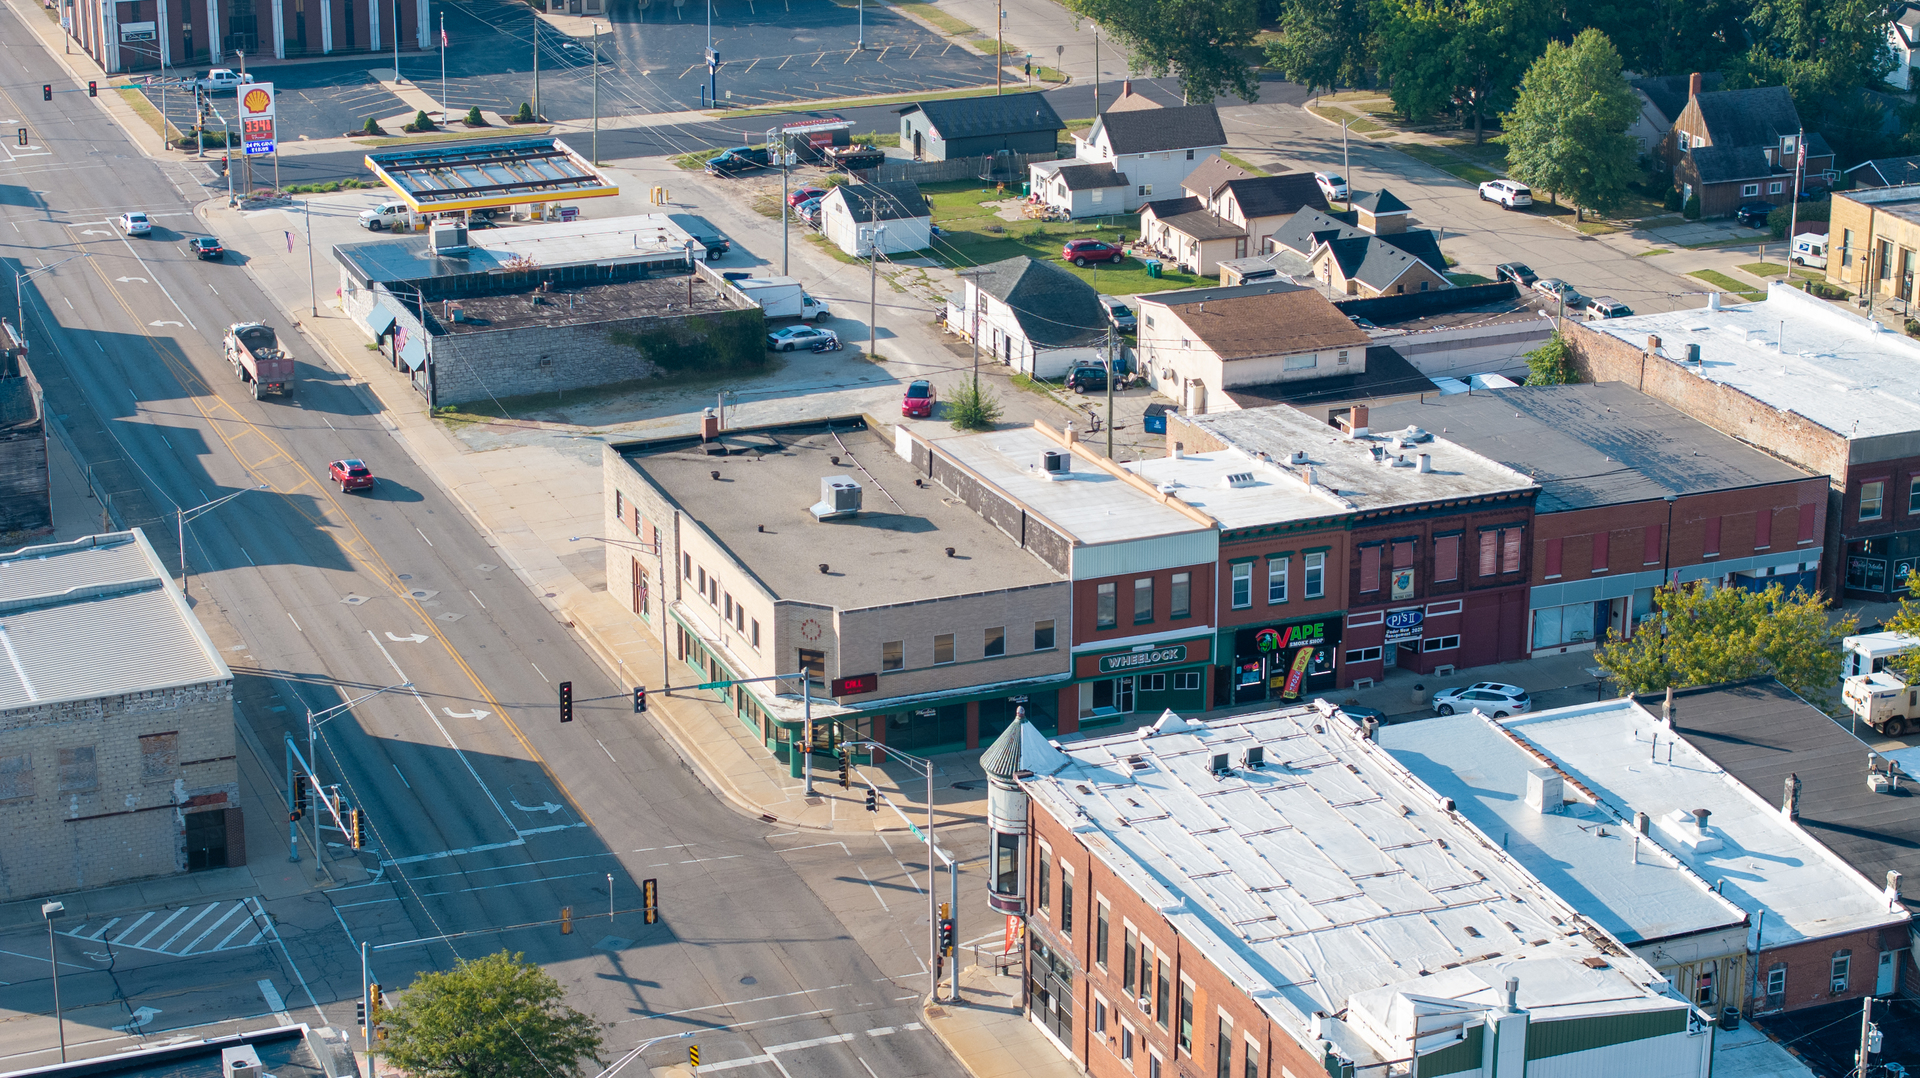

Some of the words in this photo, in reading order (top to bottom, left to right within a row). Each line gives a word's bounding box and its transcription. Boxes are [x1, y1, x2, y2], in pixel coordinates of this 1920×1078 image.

[1289, 639, 1309, 647] SMOKE
[1108, 648, 1179, 668] WHEELOCK
[844, 679, 864, 689] CALL
